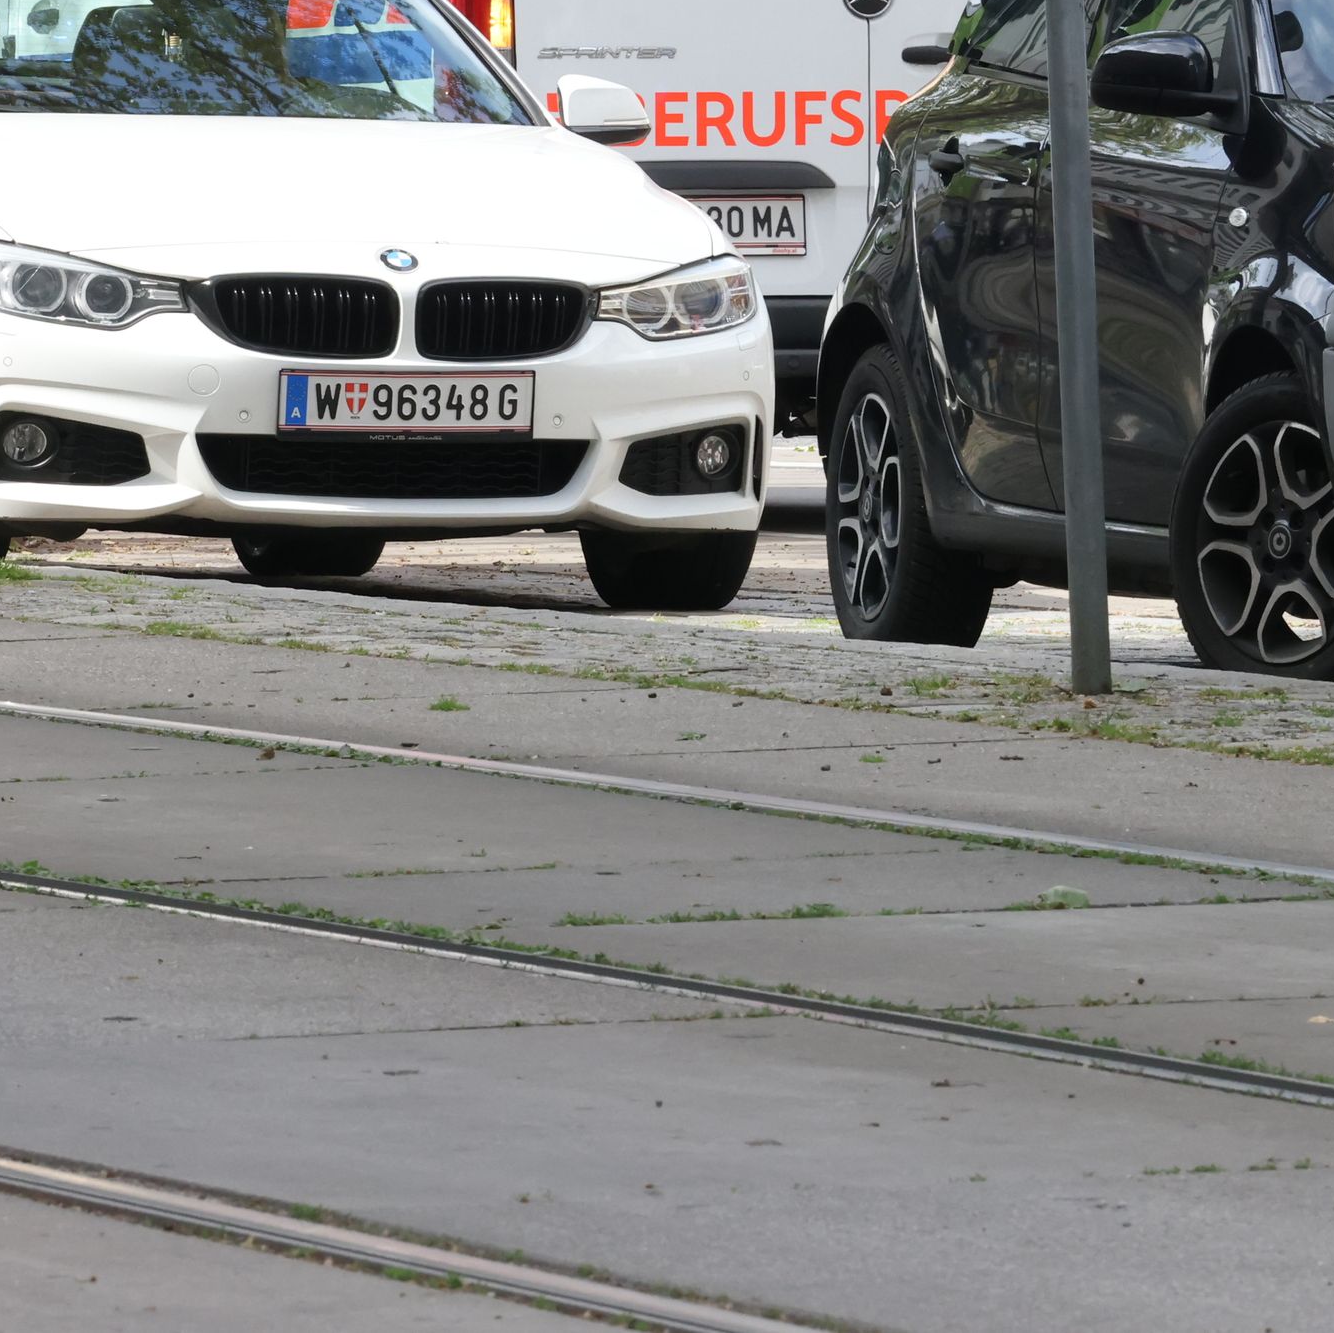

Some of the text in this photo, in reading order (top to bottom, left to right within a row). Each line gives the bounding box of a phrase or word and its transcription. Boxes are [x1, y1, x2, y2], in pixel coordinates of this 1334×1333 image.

[537, 47, 678, 60] SPRINTER
[752, 205, 796, 238] MA
[290, 406, 302, 418] A
[315, 382, 342, 420] W
